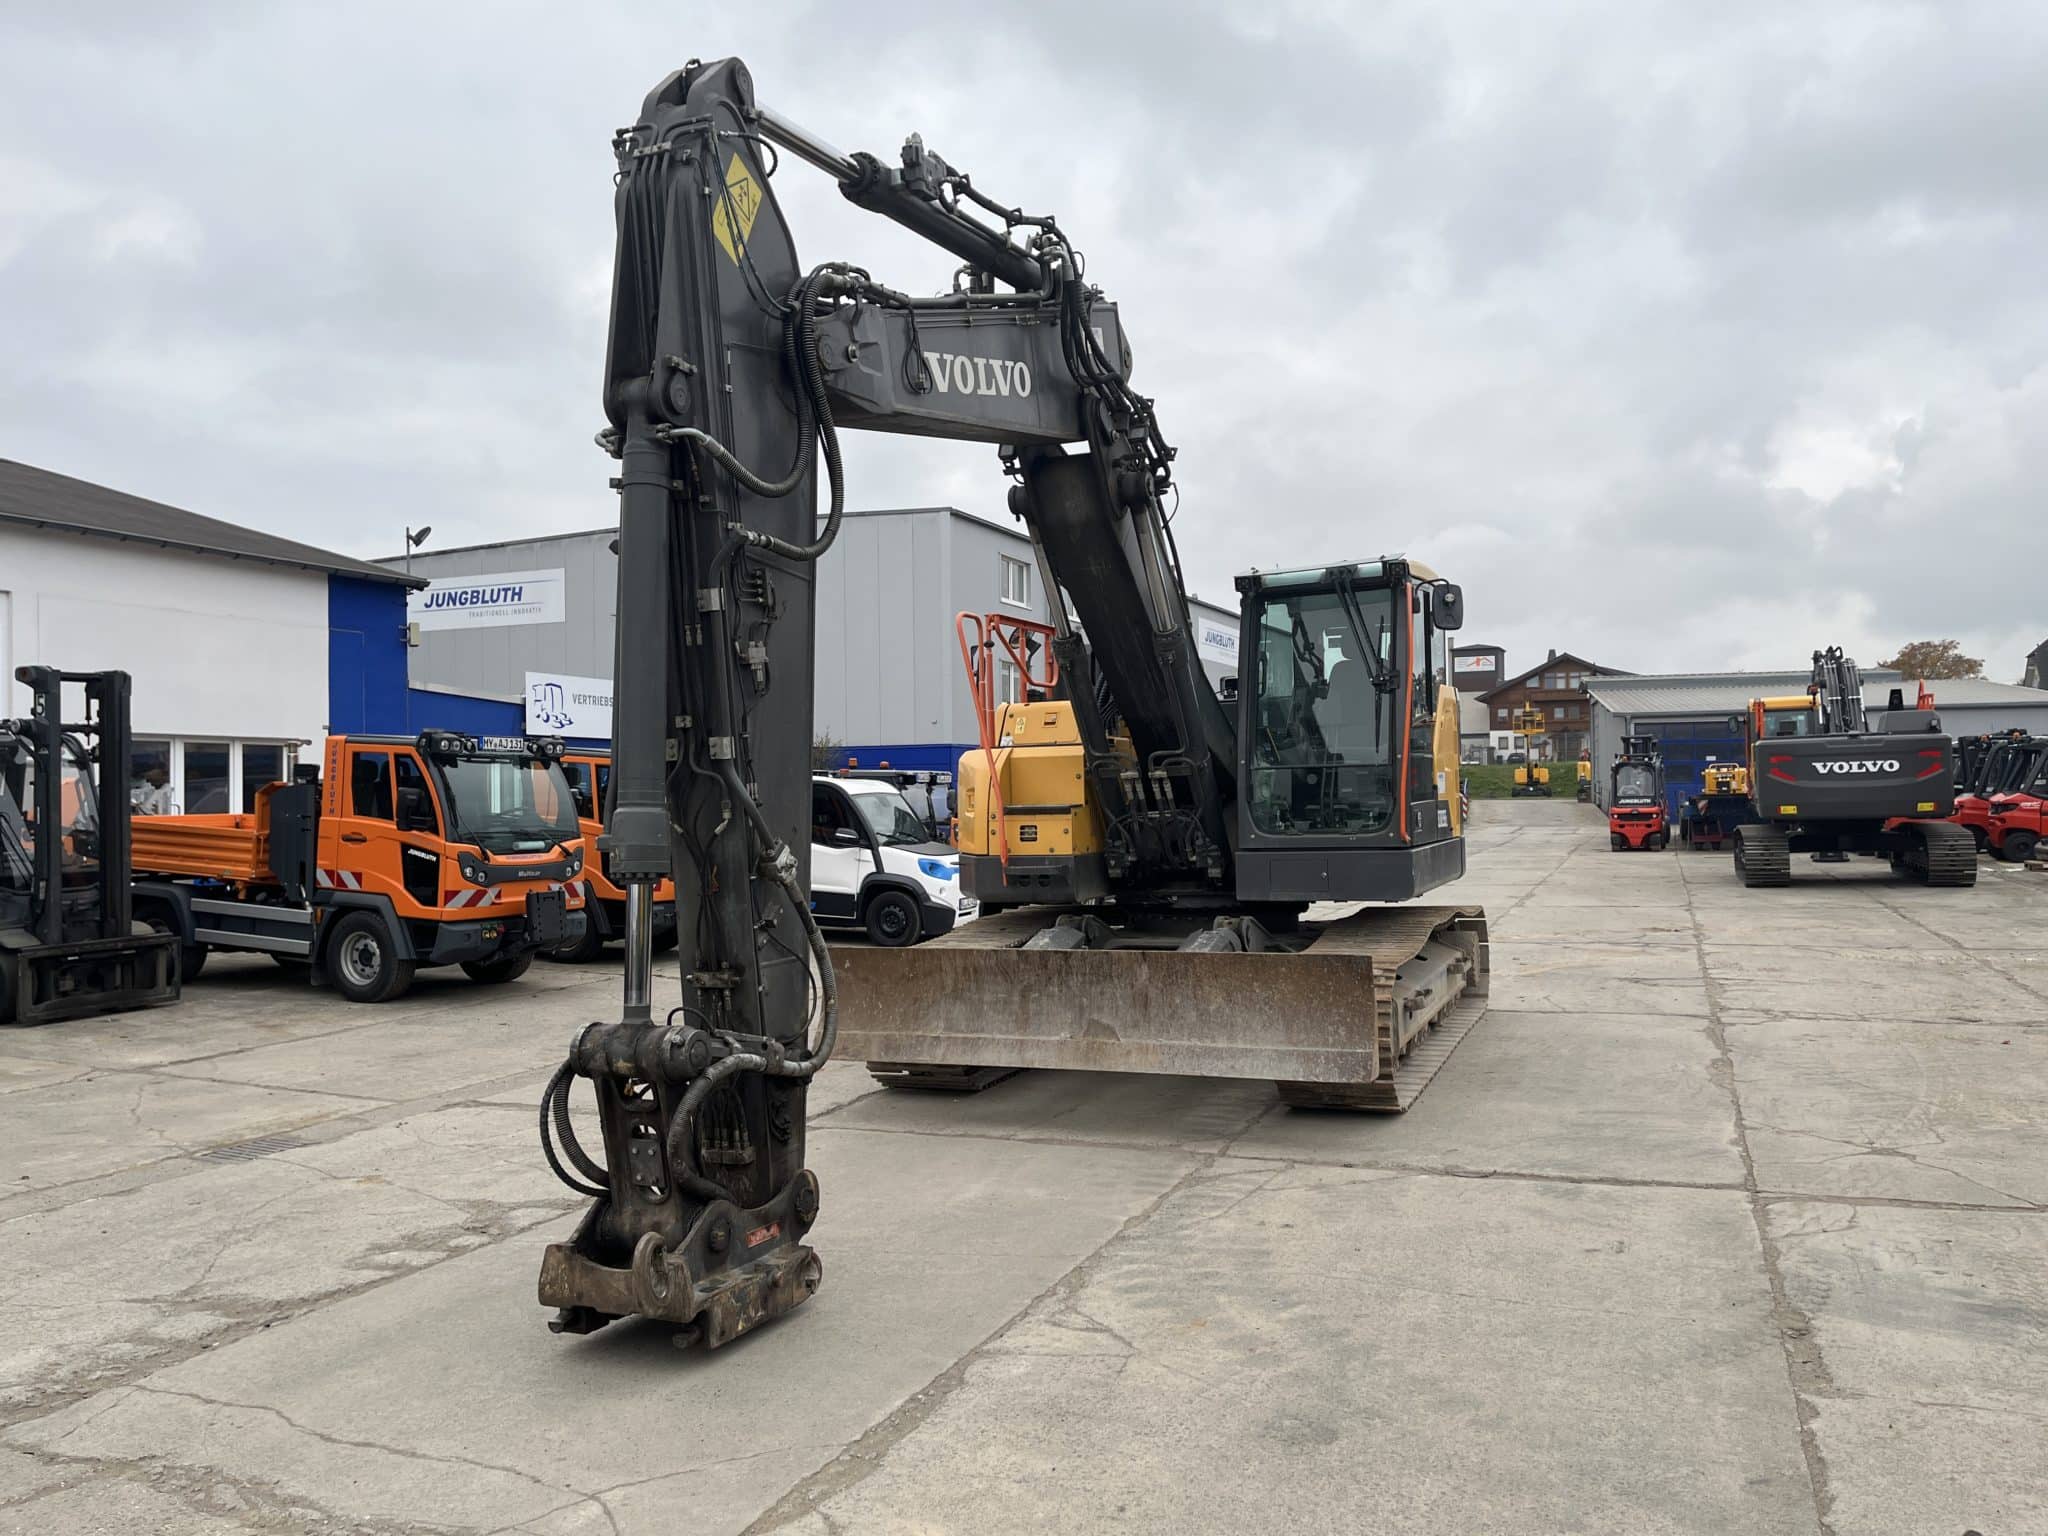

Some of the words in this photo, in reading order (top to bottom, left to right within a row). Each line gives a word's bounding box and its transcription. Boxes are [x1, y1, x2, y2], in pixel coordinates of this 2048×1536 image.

[924, 352, 1031, 398] VOLVO
[424, 586, 523, 608] JUNGBLUTH
[1812, 759, 1900, 774] VOLVO
